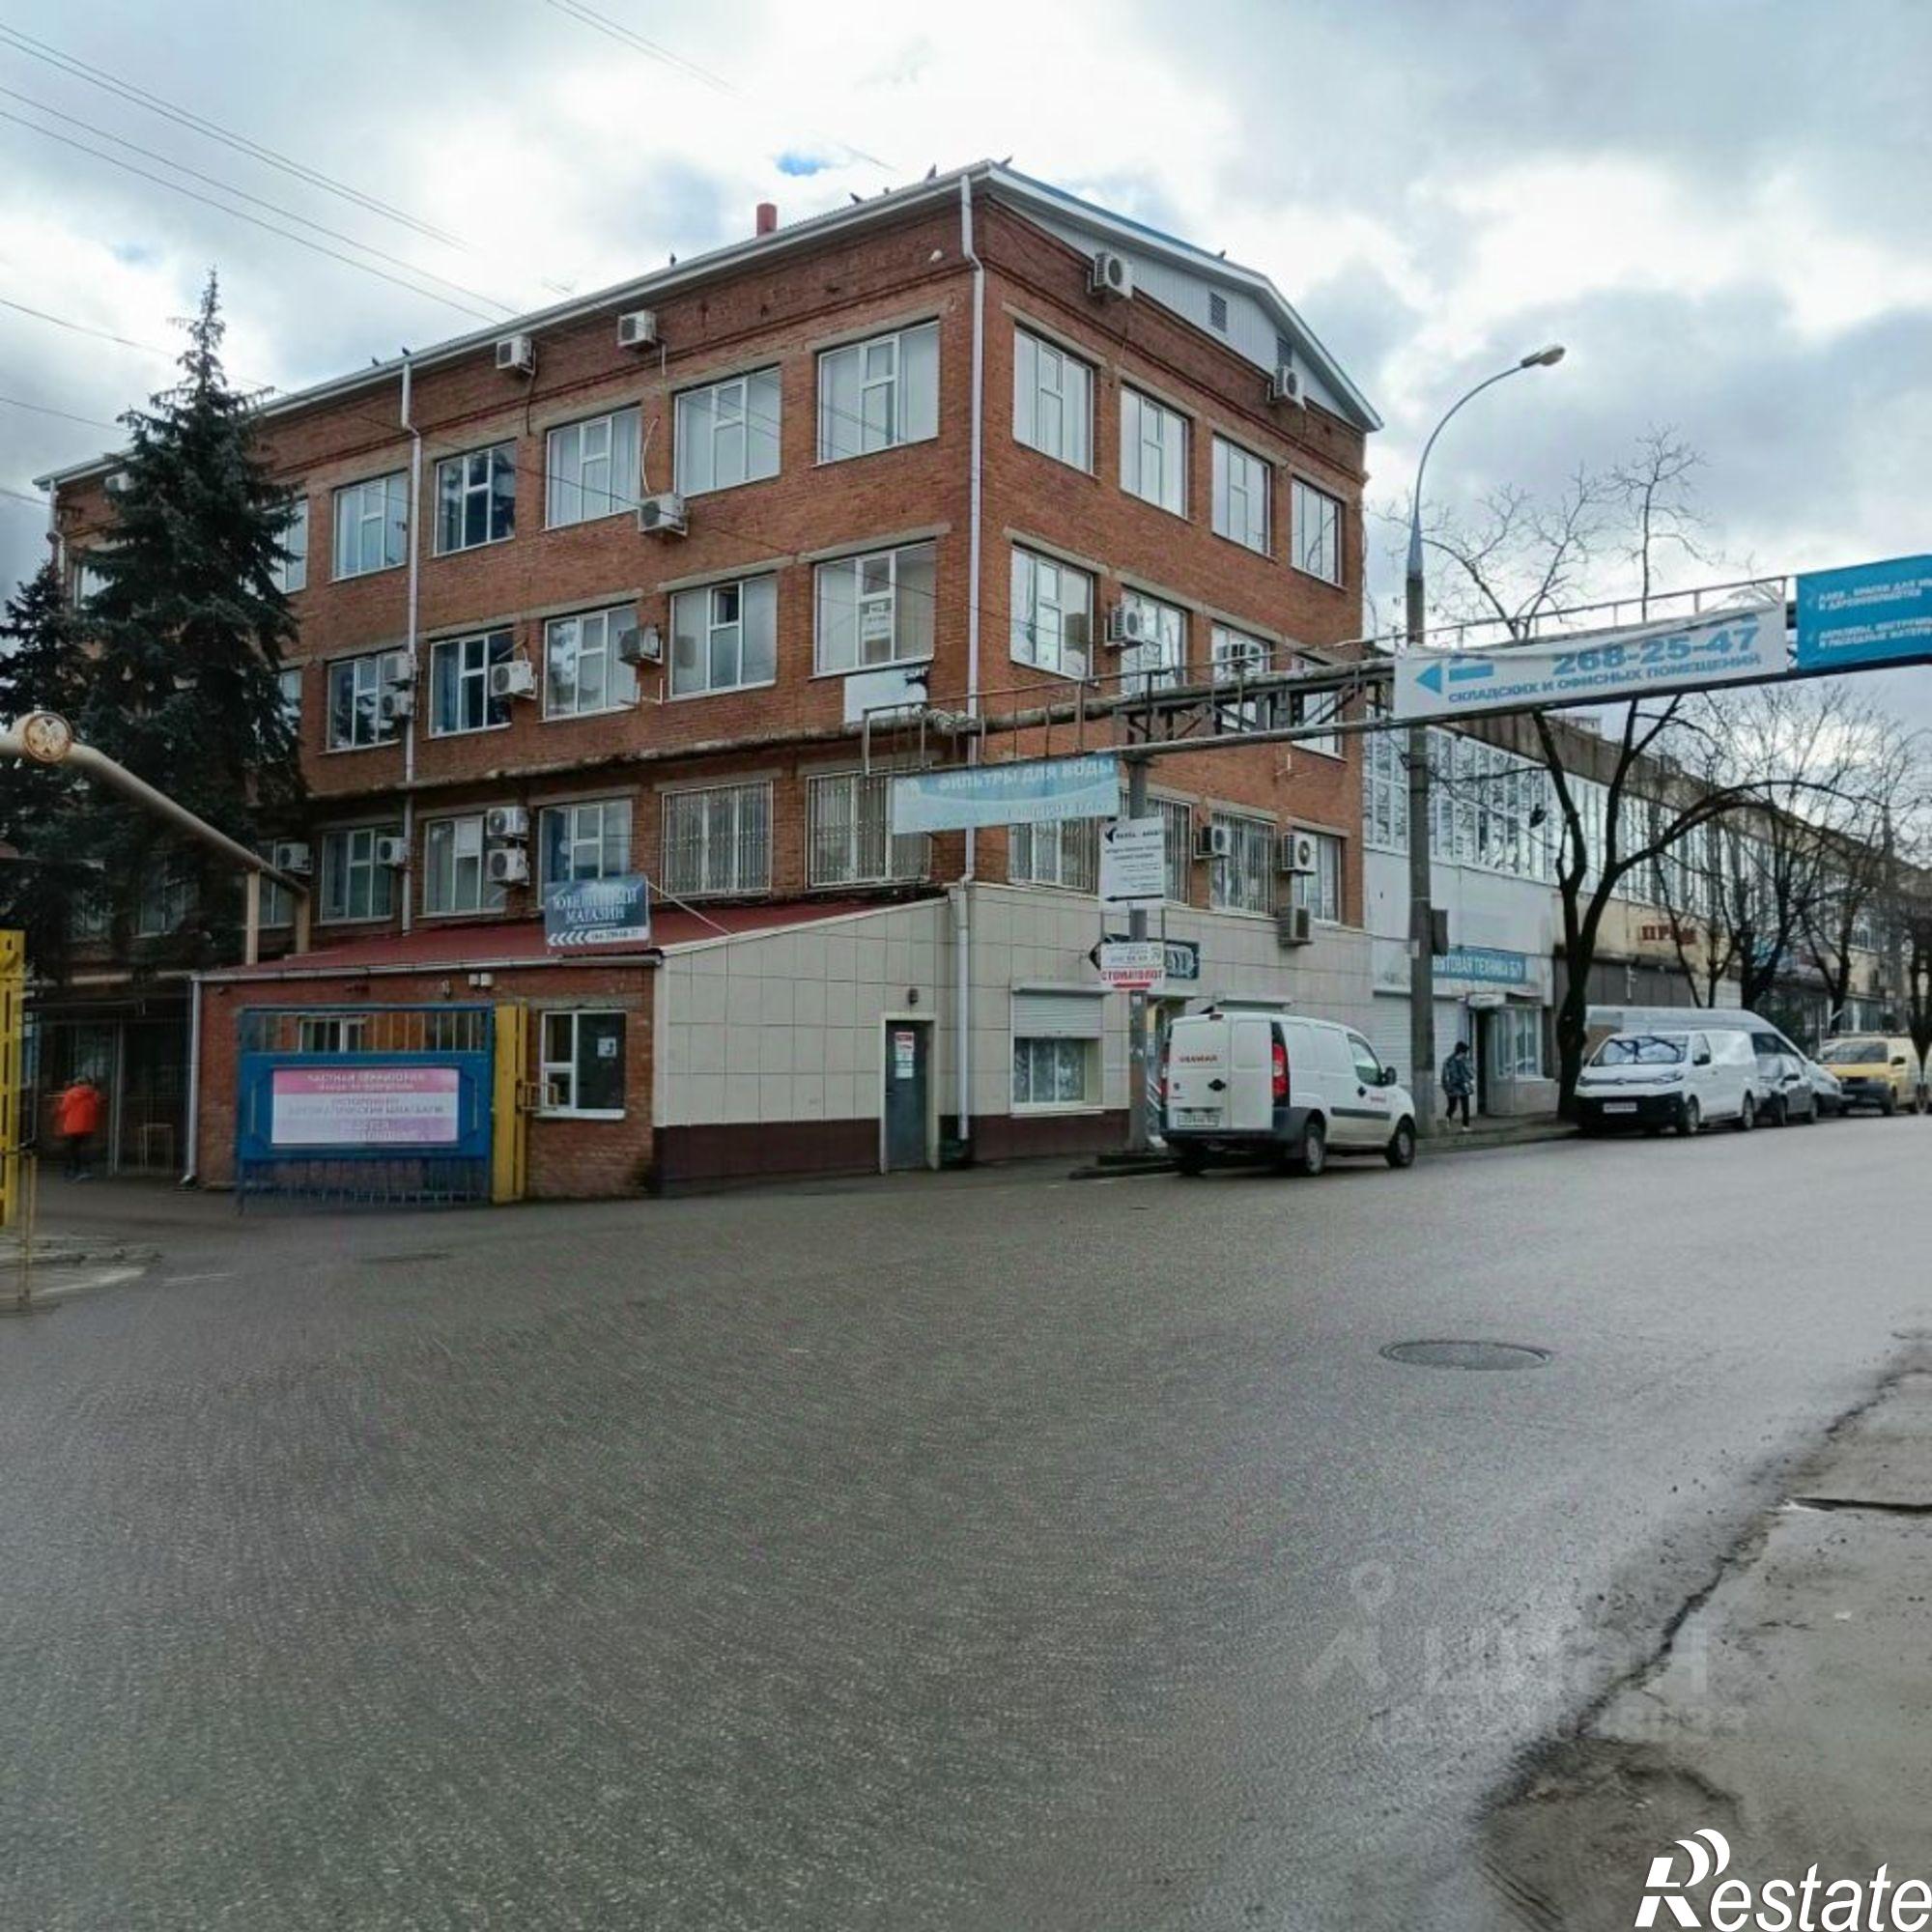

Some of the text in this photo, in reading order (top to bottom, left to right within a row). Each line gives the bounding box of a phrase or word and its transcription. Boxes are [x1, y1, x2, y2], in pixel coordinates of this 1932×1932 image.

[1553, 625, 1758, 675] 268-25-47
[1449, 652, 1761, 703] СКЛАДСКИХ И ОФИСНЫХ ПОМЕЩЕНИЙ
[938, 758, 1115, 791] ФИЛЬТРЫ ДЛЯ ВОДЫ
